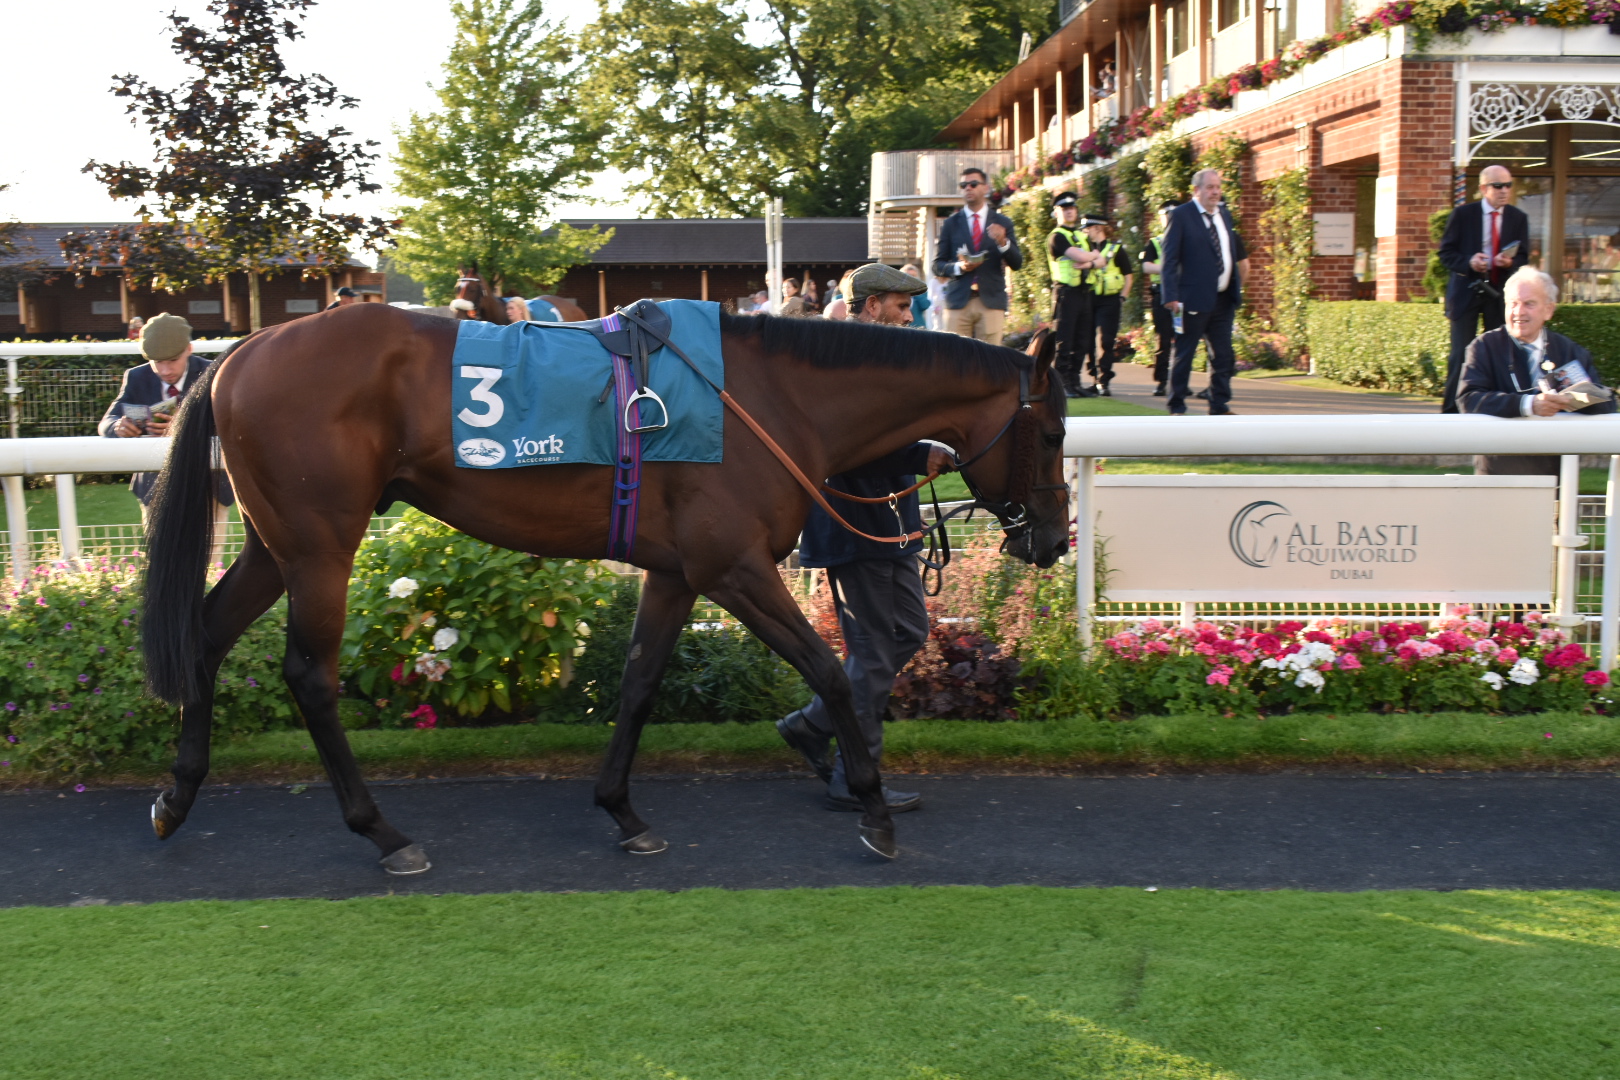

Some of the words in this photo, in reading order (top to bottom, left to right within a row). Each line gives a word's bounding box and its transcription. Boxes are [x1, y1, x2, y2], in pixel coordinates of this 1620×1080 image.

[457, 365, 505, 428] 3
[512, 434, 565, 457] York
[517, 456, 561, 464] RACECOURSE
[1285, 521, 1325, 546] AL
[1336, 521, 1419, 546] BASTI
[1286, 545, 1418, 566] EQUIWORLD
[1330, 569, 1374, 580] DUBAI
